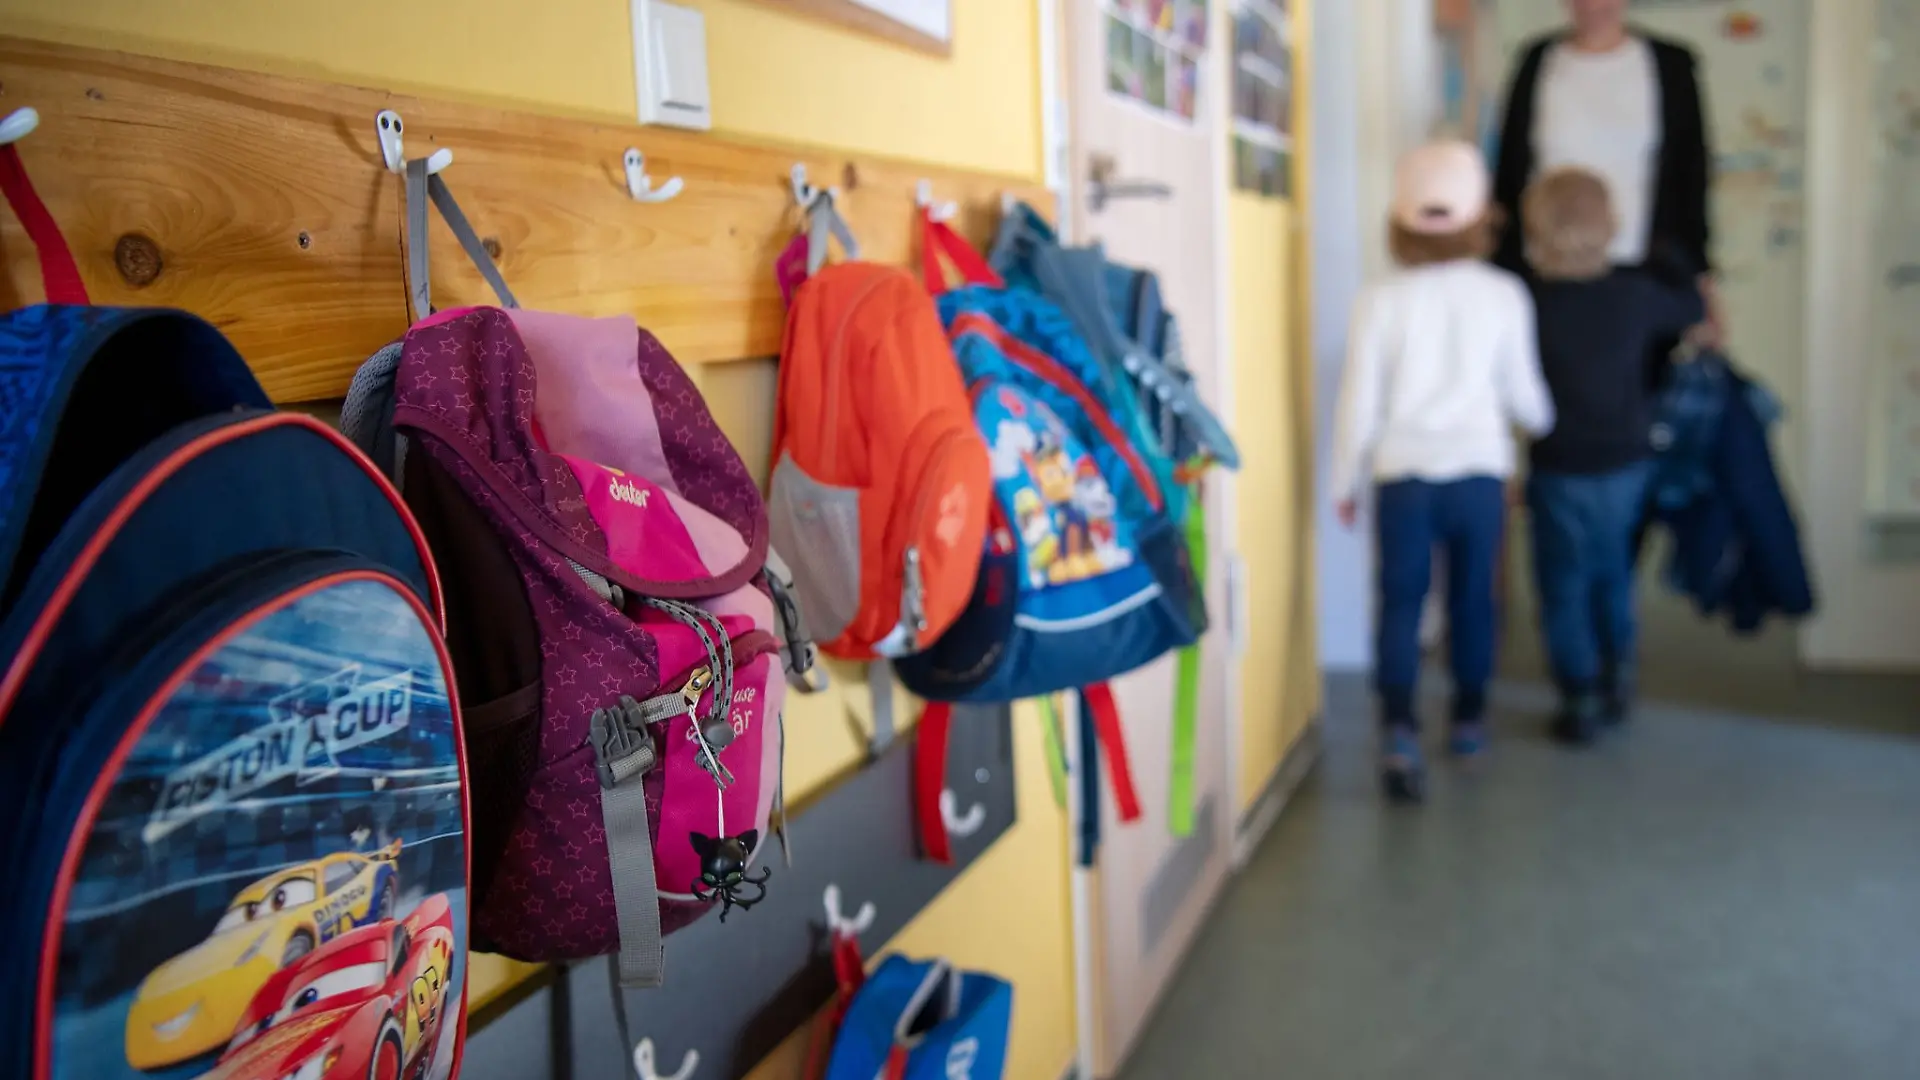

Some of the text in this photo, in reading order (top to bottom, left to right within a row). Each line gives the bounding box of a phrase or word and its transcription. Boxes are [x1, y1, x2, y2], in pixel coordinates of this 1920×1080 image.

[609, 476, 650, 508] deuter
[333, 686, 408, 741] CUP
[732, 708, 753, 736] är
